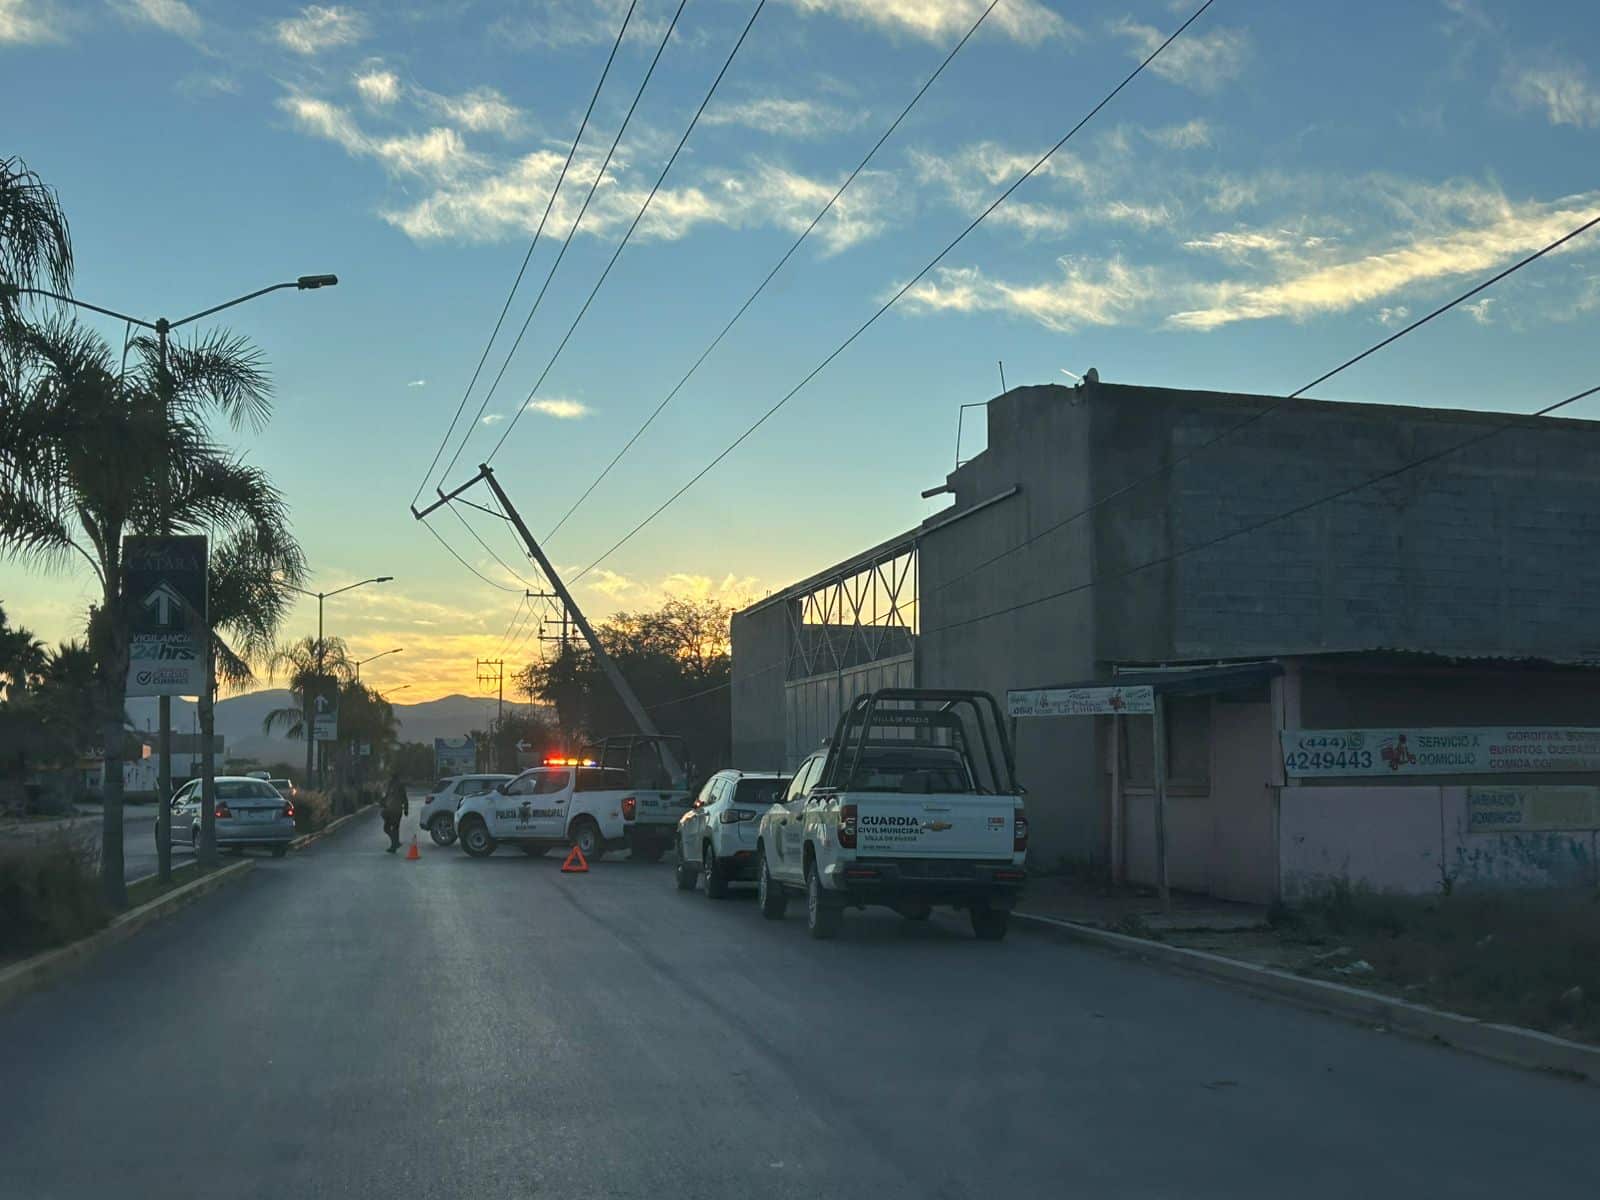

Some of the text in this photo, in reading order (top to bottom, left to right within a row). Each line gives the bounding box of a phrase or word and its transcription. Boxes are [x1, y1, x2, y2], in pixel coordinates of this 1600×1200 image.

[1418, 735, 1469, 748] SERVICIO
[1286, 750, 1373, 769] 4249443
[1418, 752, 1476, 765] DOMICILIO
[862, 816, 919, 826] GUARDIA
